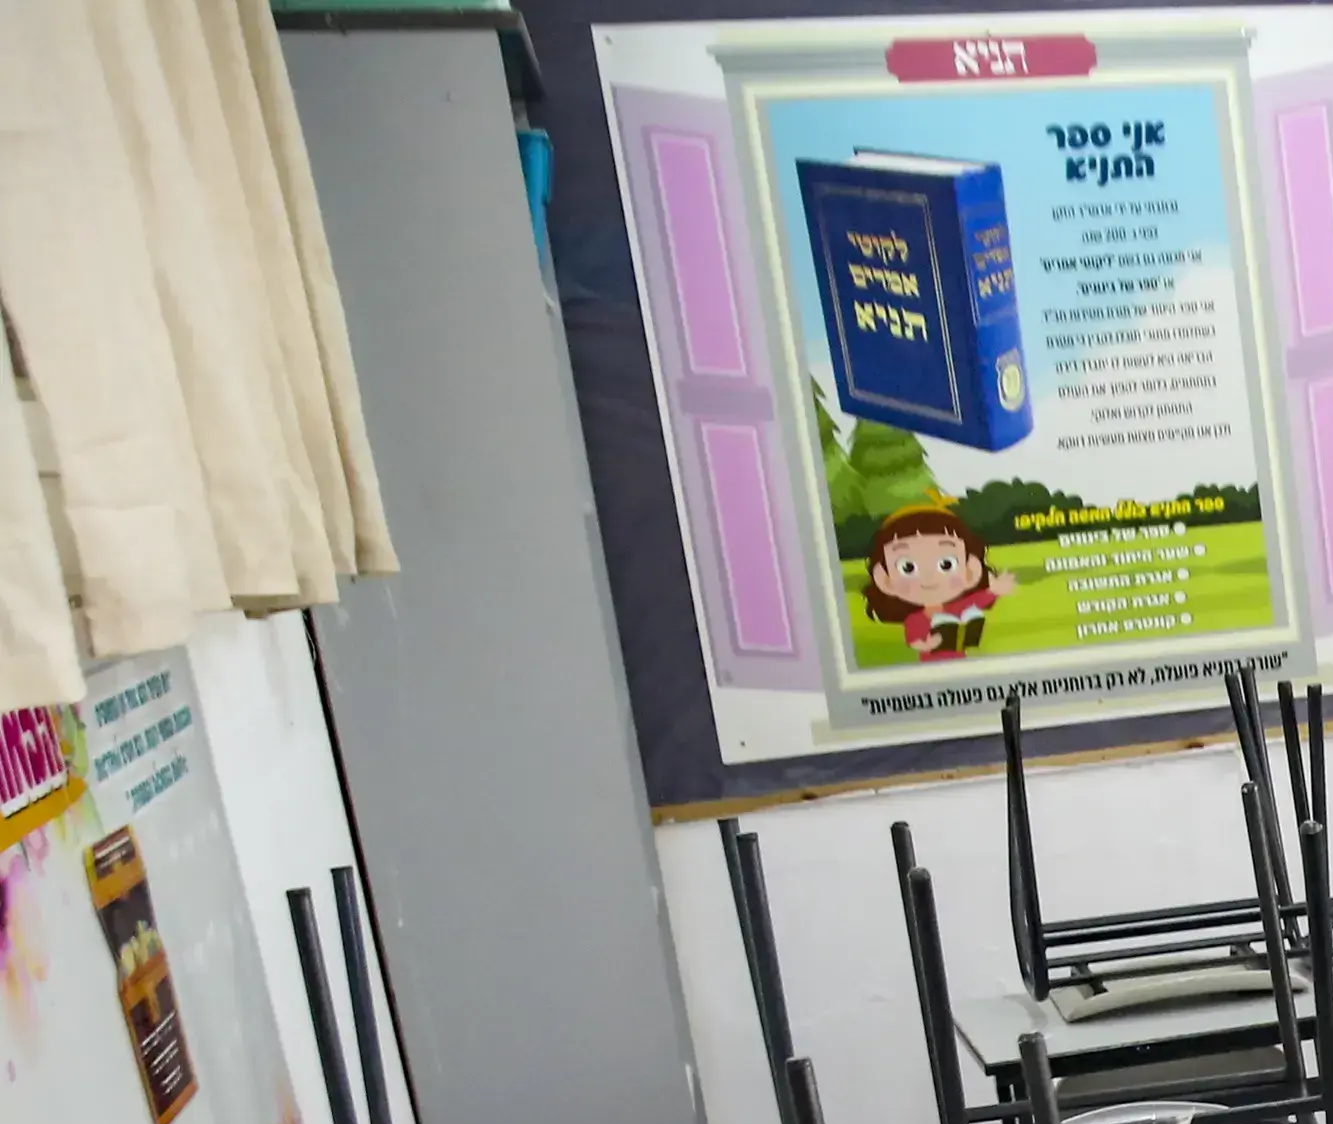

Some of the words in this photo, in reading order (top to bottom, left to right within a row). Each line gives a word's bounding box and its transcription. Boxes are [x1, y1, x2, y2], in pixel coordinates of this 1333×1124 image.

[952, 39, 1029, 76] תניא
[1046, 123, 1111, 150] ספר
[1122, 120, 1166, 152] אני
[1066, 152, 1155, 187] התניא
[847, 230, 909, 266] לקוטי
[848, 260, 921, 298] אמרים
[854, 300, 928, 343] תניא
[1151, 498, 1191, 517] התניא
[1195, 496, 1225, 512] ספר
[1111, 525, 1136, 541] של
[1139, 524, 1171, 539] ספר
[1157, 546, 1189, 560] שער
[1068, 573, 1131, 592] התשובה
[1135, 569, 1173, 585] אגרת
[1077, 597, 1128, 614] הקודש
[1132, 593, 1170, 608] אגרת
[1077, 619, 1119, 640] אחרון
[1124, 614, 1176, 633] קונטרס
[1128, 667, 1146, 685] לא
[1150, 663, 1199, 685] פועלת,
[1203, 658, 1241, 677] בתניא
[1042, 672, 1103, 695] ברוחניות
[1106, 671, 1124, 690] רק
[937, 687, 983, 707] פעולה
[986, 685, 1005, 702] גם
